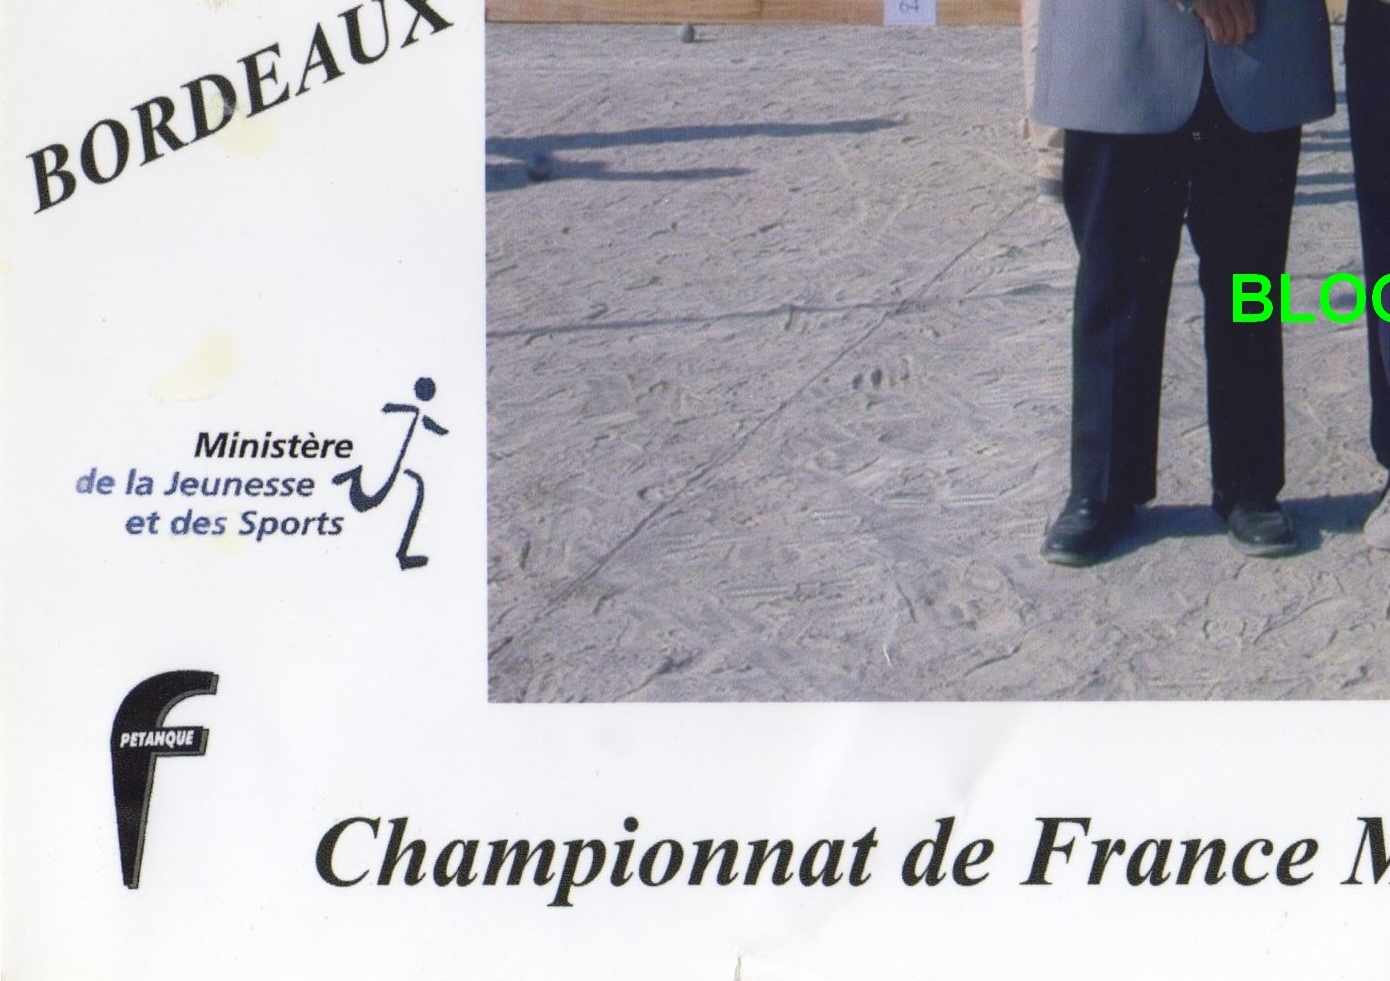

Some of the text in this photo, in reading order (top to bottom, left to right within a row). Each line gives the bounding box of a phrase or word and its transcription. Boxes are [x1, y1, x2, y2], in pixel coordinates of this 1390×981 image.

[194, 431, 354, 459] Ministère
[75, 467, 315, 497] de la Jeunesse
[125, 509, 344, 541] et des Sports
[120, 730, 195, 748] PETANQUE
[312, 816, 877, 907] Championnat
[900, 816, 995, 888] de
[1020, 816, 1318, 887] France
